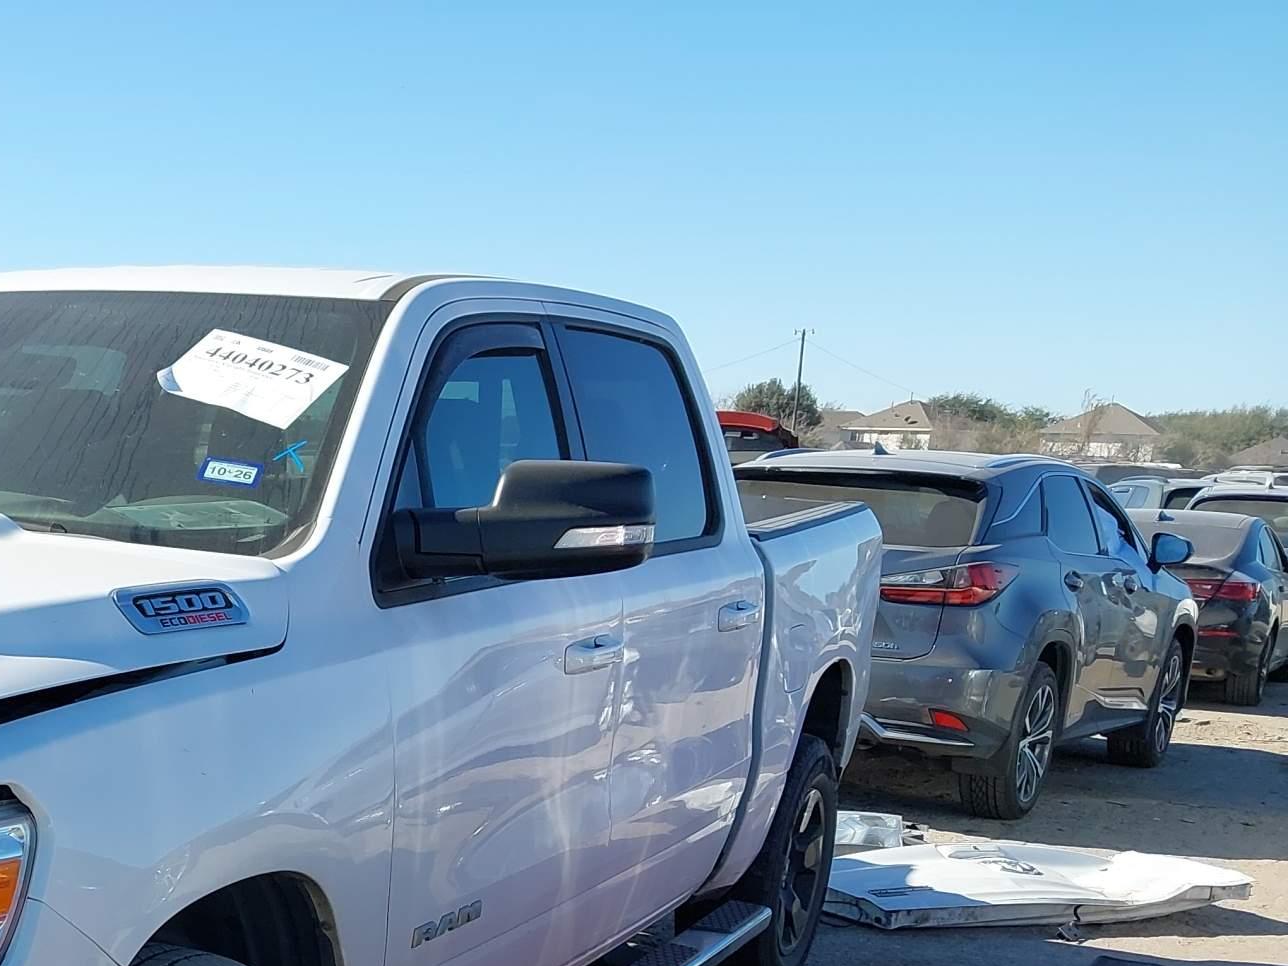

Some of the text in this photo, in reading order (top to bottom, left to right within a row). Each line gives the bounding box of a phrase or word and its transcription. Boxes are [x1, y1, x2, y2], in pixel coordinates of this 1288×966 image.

[205, 345, 314, 385] 44040273
[136, 591, 226, 616] 1500
[160, 612, 232, 628] ECODIESEL
[411, 899, 482, 949] RAM
